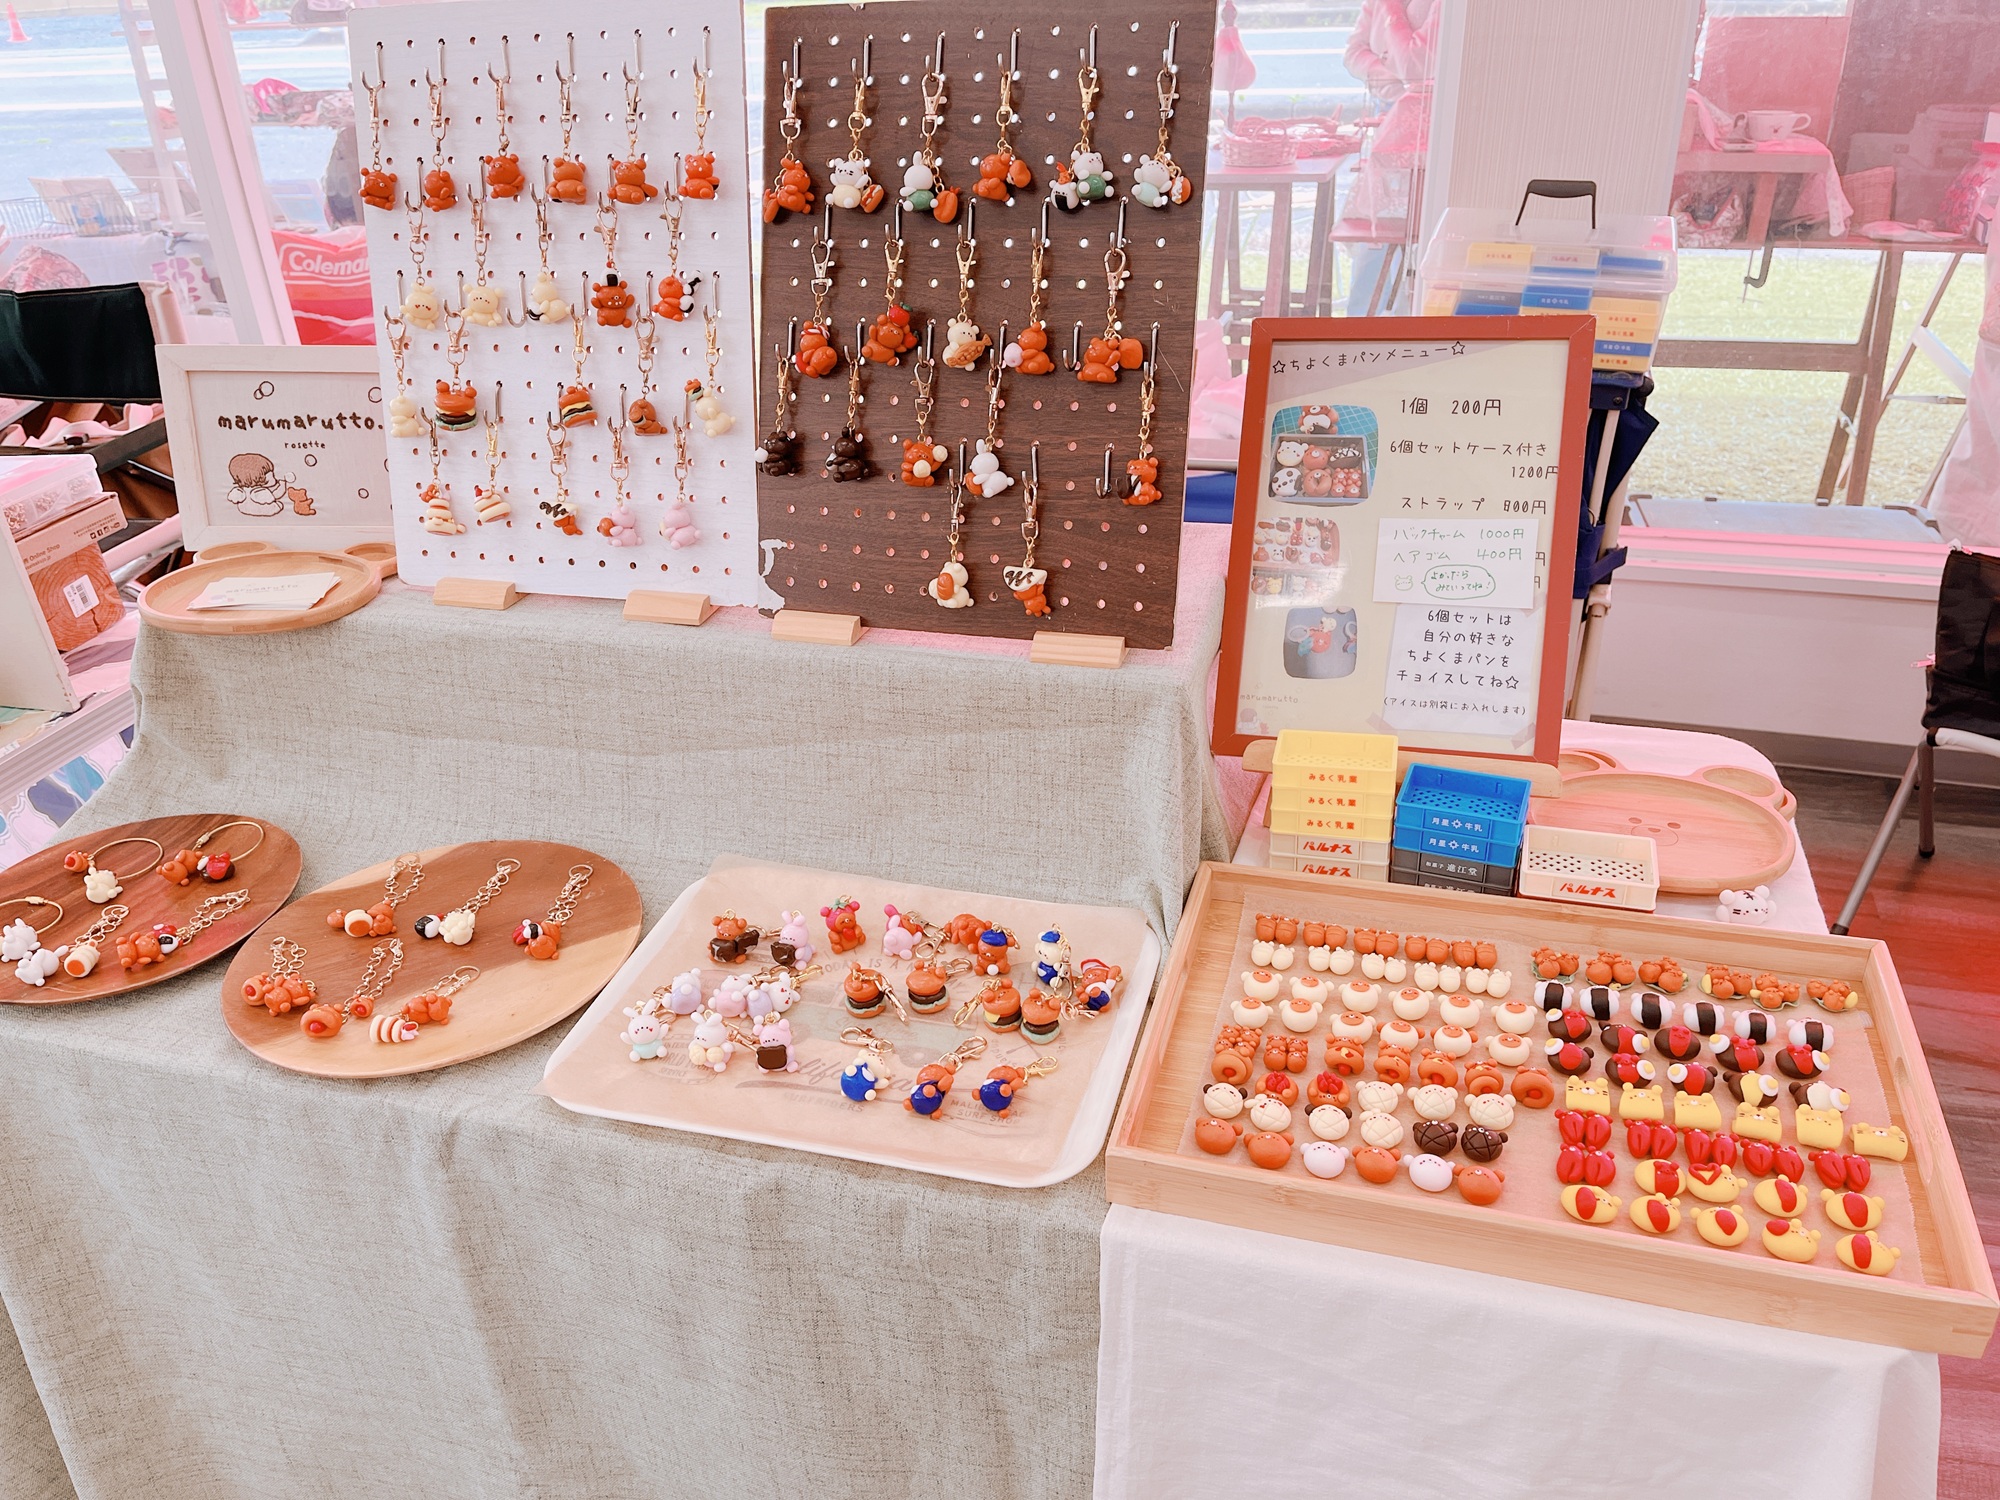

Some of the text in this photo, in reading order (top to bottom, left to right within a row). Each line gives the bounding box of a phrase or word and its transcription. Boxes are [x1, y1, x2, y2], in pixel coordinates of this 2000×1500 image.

[1401, 397, 1501, 416] 1個 200円
[284, 440, 327, 449] rosette
[1390, 440, 1548, 456] 6個セットケース付き
[1511, 465, 1558, 480] 1200円
[1401, 496, 1547, 515] ストラップ 800円
[1479, 528, 1525, 540] 1000円
[1476, 547, 1523, 561] 400円
[1427, 609, 1512, 626] 6個セットは
[1423, 629, 1514, 647] 自分の好きな
[1308, 773, 1358, 784] みるく乳業
[1307, 797, 1356, 807] みるく乳業
[1306, 820, 1355, 831] みるく乳業
[1303, 841, 1353, 855] パルナス
[1559, 882, 1617, 899] パルナス
